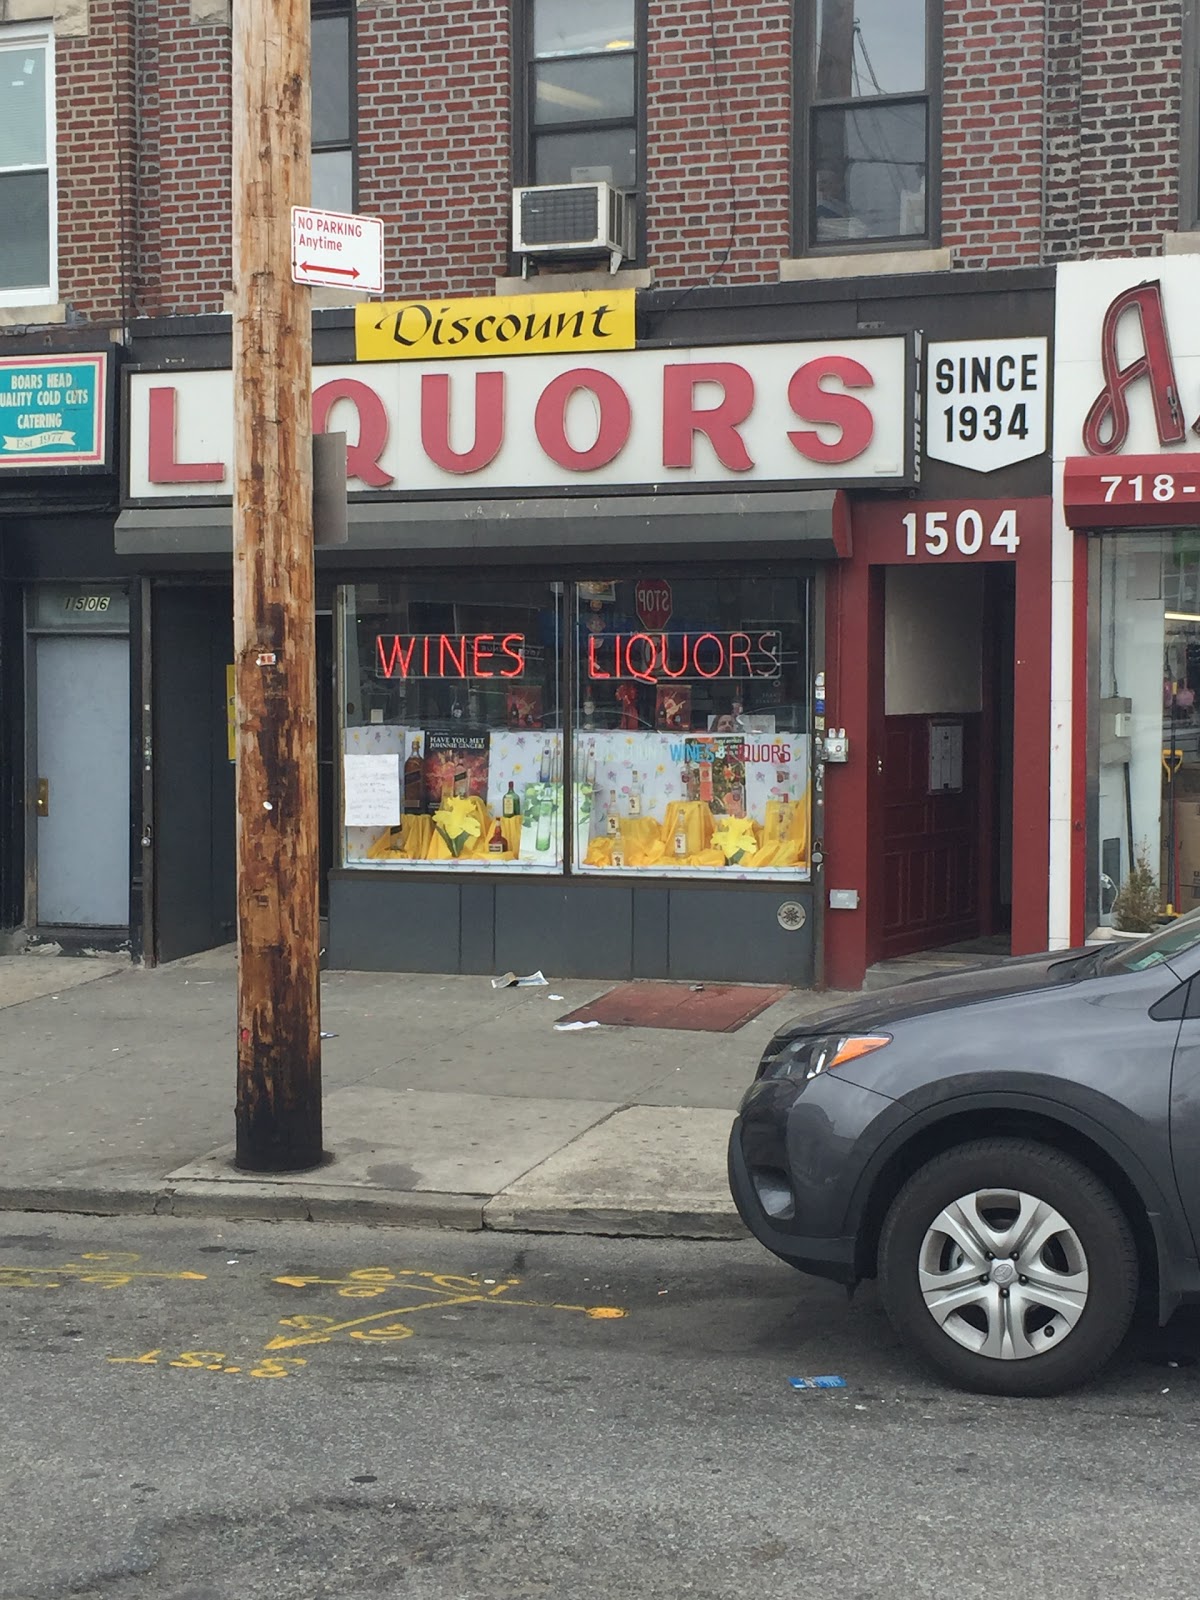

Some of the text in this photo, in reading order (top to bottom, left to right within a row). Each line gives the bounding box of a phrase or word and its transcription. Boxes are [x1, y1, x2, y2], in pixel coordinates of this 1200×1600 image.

[298, 217, 362, 237] NO PARKING
[299, 233, 342, 251] Anytime
[374, 303, 616, 347] Discount
[11, 372, 73, 390] BOARS HEAD
[935, 354, 1038, 394] SINCE
[37, 390, 61, 405] COLD
[65, 389, 88, 405] CUTS
[17, 413, 63, 429] CATERING
[148, 354, 876, 487] LQUORS
[944, 403, 1029, 443] 1934
[40, 432, 65, 445] 1977
[1100, 474, 1196, 503] 718-
[902, 508, 1021, 556] 1504
[65, 598, 108, 611] 1506
[376, 633, 525, 679] WINES
[588, 632, 780, 684] LIQUORS
[670, 743, 715, 763] WINES
[727, 744, 791, 763] LIQUORS
